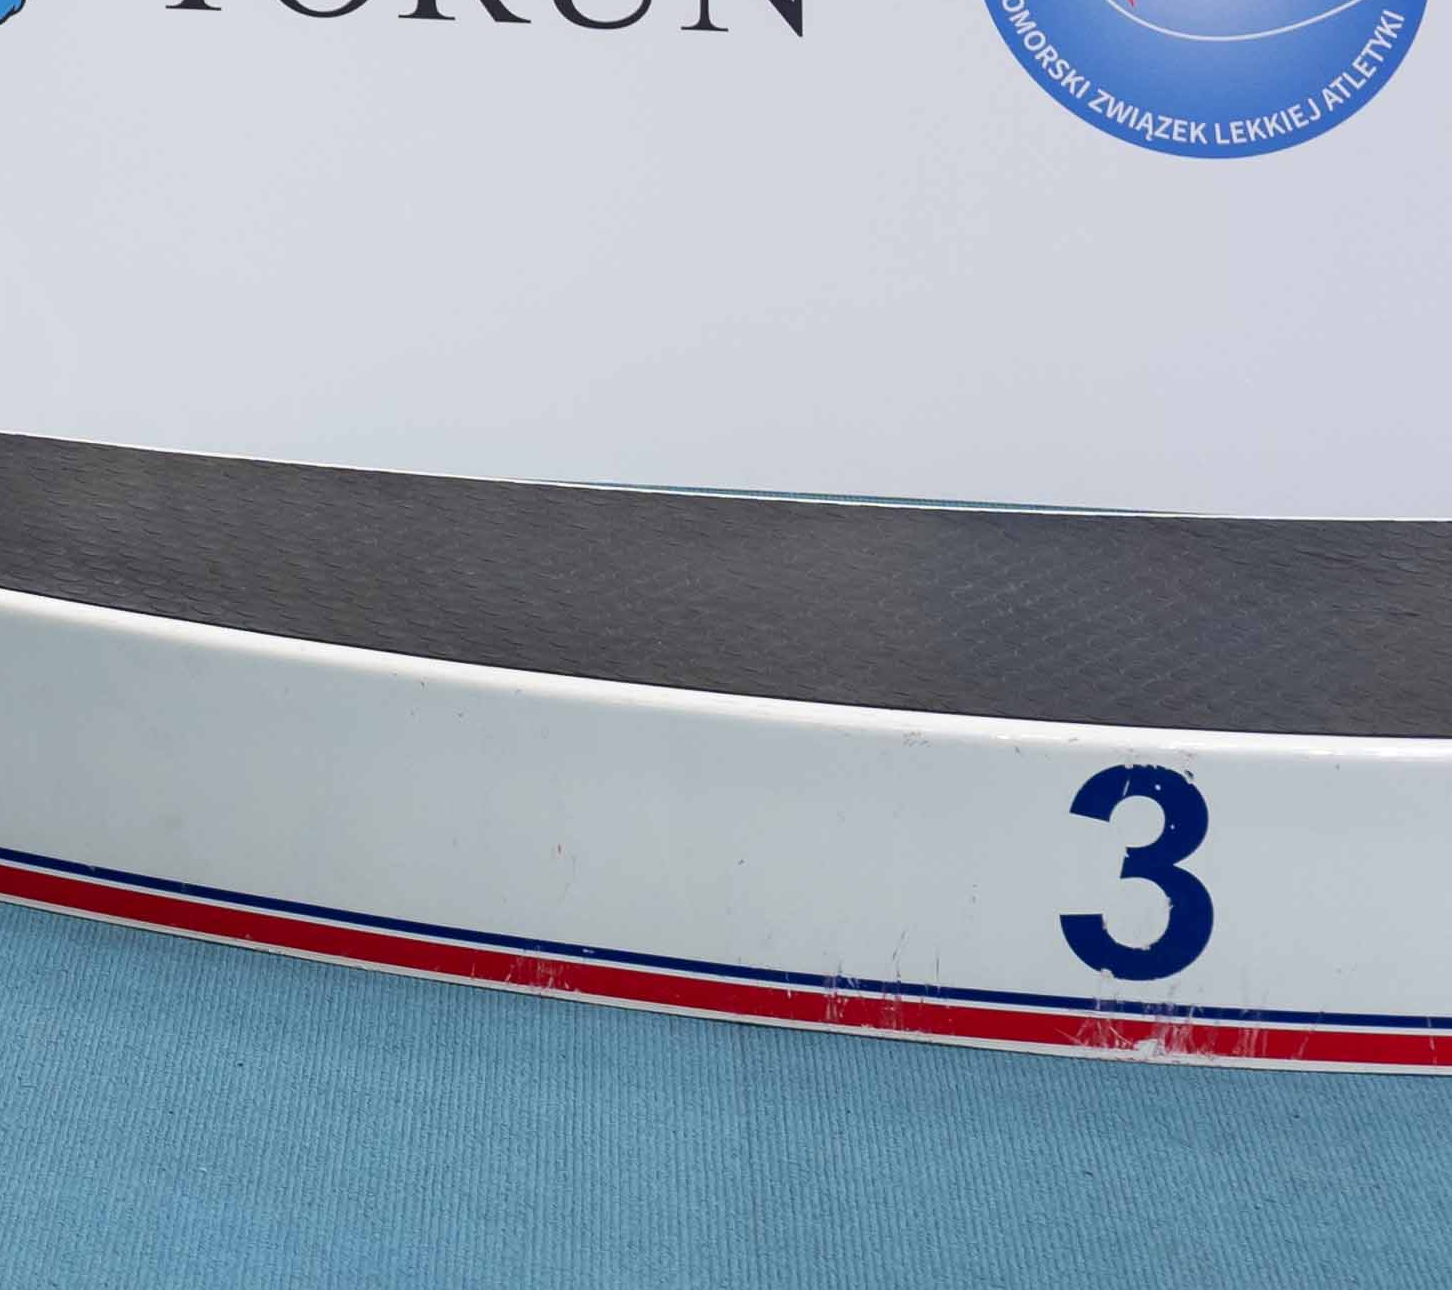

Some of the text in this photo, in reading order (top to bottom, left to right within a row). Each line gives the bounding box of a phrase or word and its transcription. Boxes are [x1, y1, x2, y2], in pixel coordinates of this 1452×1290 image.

[1088, 89, 1207, 145] ZWIĄZEK
[1214, 97, 1323, 146] LEKKIEJ
[1324, 8, 1407, 112] ATLETYKI
[1060, 764, 1214, 980] 3
